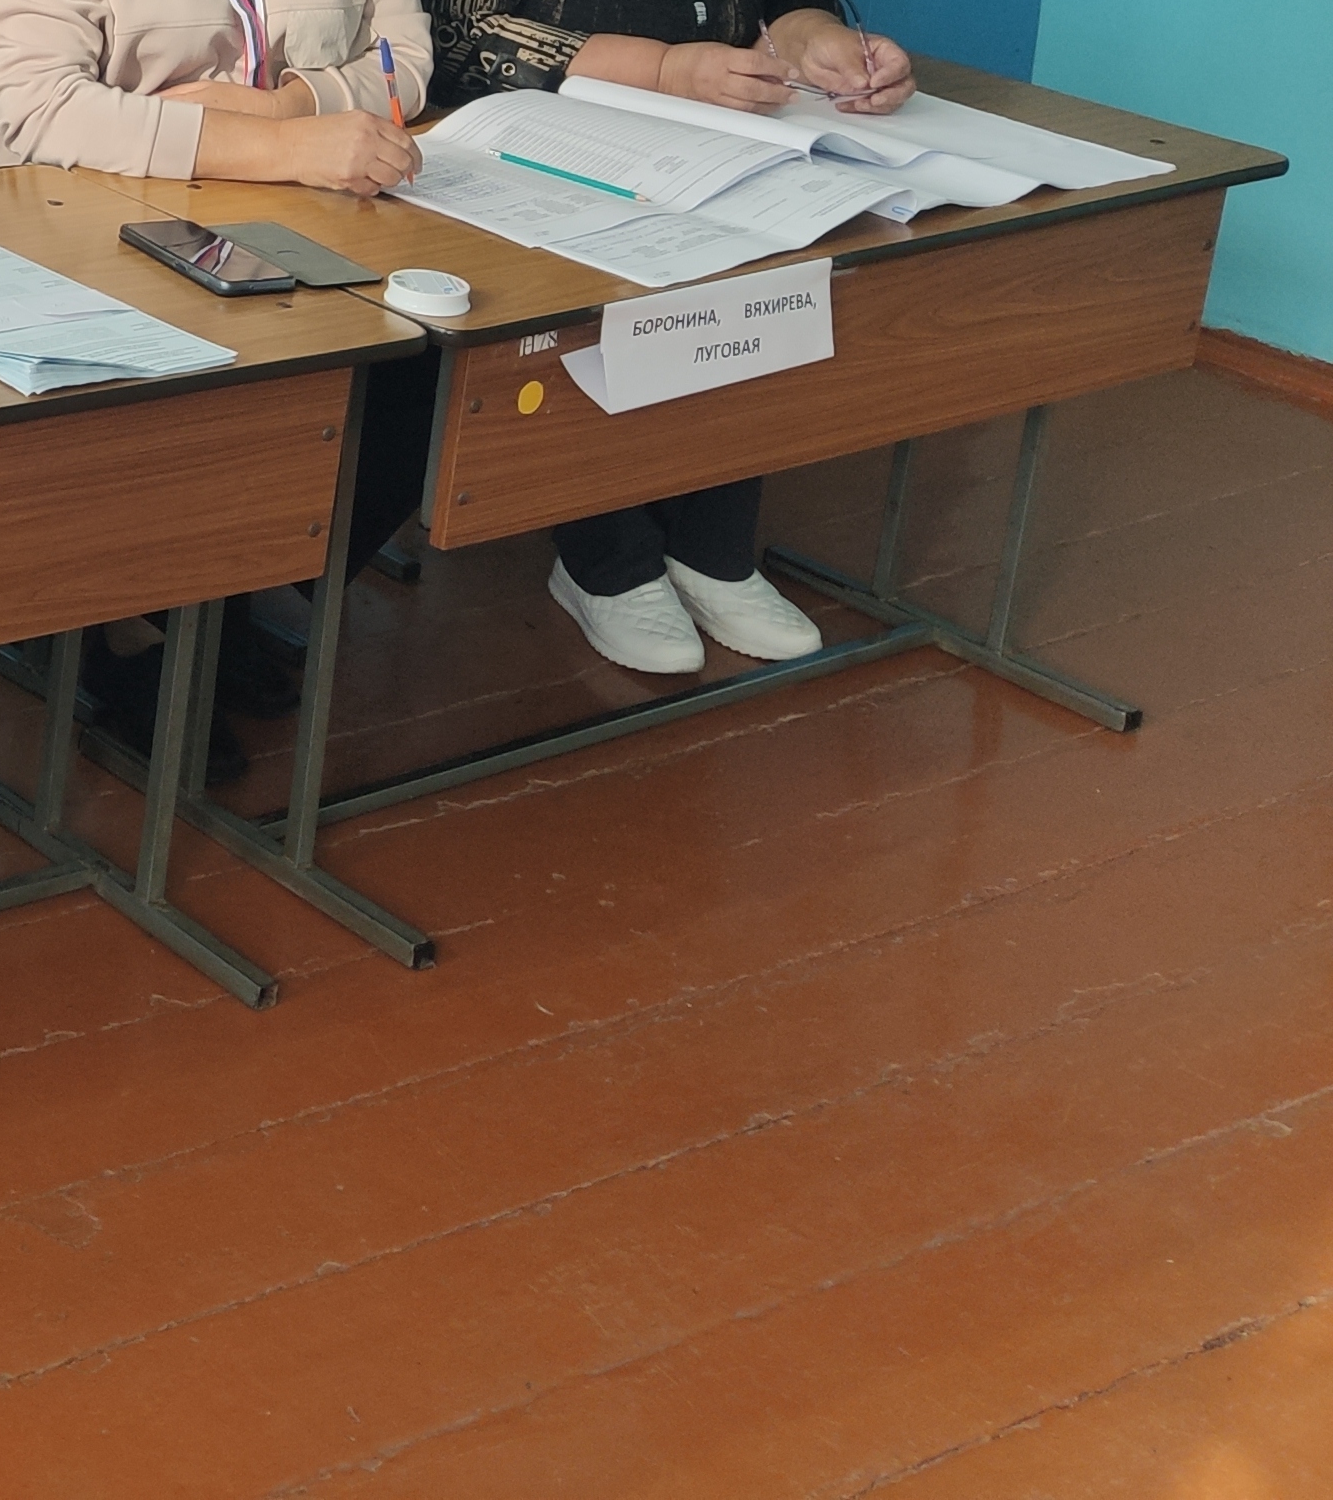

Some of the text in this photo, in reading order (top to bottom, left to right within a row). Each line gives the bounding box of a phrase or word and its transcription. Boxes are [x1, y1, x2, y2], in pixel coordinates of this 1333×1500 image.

[632, 291, 818, 337] БОРОНИНА, ВЯХИРЕВА,
[694, 337, 761, 364] ЛУГОВАЯ
